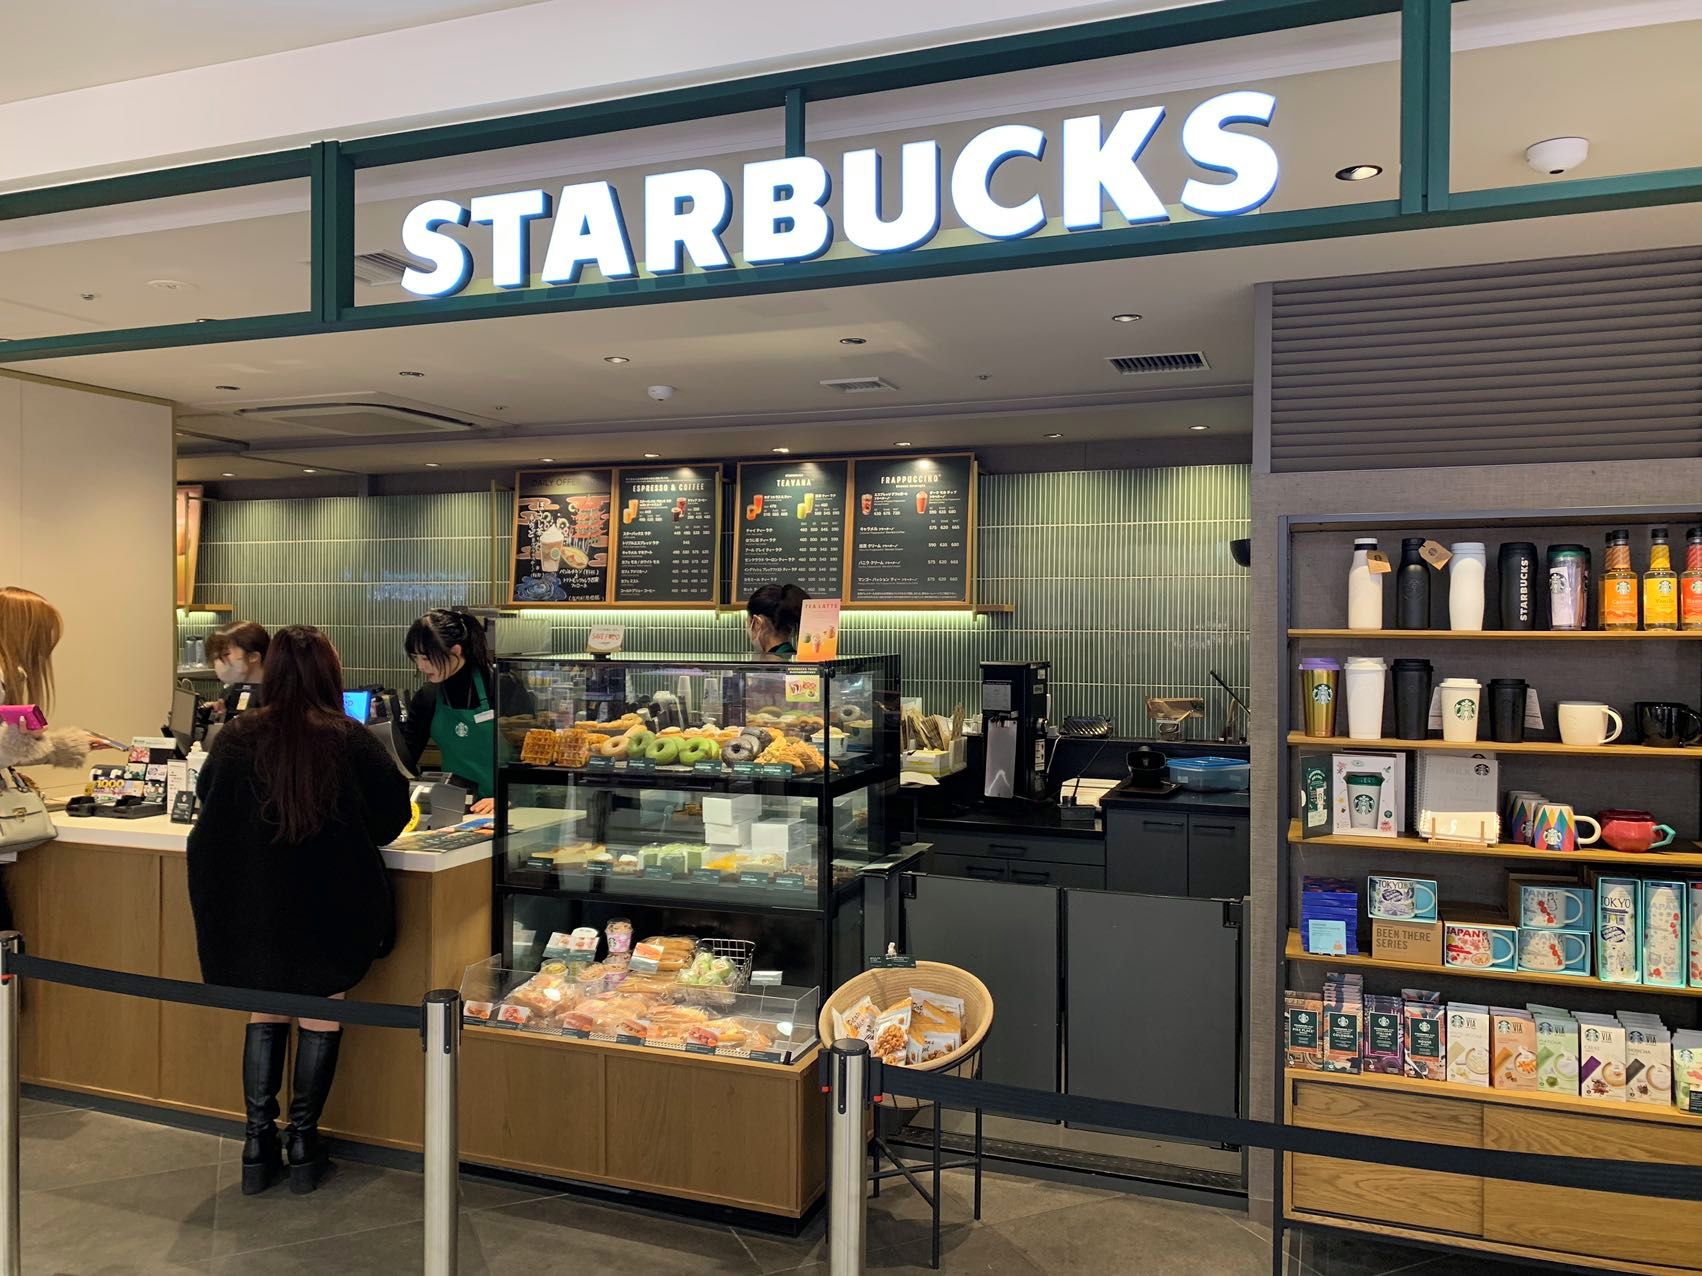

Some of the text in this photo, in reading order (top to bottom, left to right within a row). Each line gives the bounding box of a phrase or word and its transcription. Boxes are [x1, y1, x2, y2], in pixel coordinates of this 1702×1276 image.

[400, 91, 1278, 298] STARBUCKS
[777, 479, 812, 488] TEAVANA
[880, 475, 940, 484] FRAPPUCCINO
[632, 484, 669, 492] ESPRESSO
[678, 483, 705, 491] COFFEE
[1520, 559, 1529, 621] STARBUCKS
[1377, 880, 1403, 889] TOKYO
[1376, 928, 1431, 942] BEEN THERE
[1376, 939, 1408, 950] SERIES
[1513, 1024, 1523, 1033] VIA
[1554, 1026, 1565, 1034] VIA
[1601, 1033, 1612, 1041] VIA
[1646, 1036, 1657, 1044] VIA
